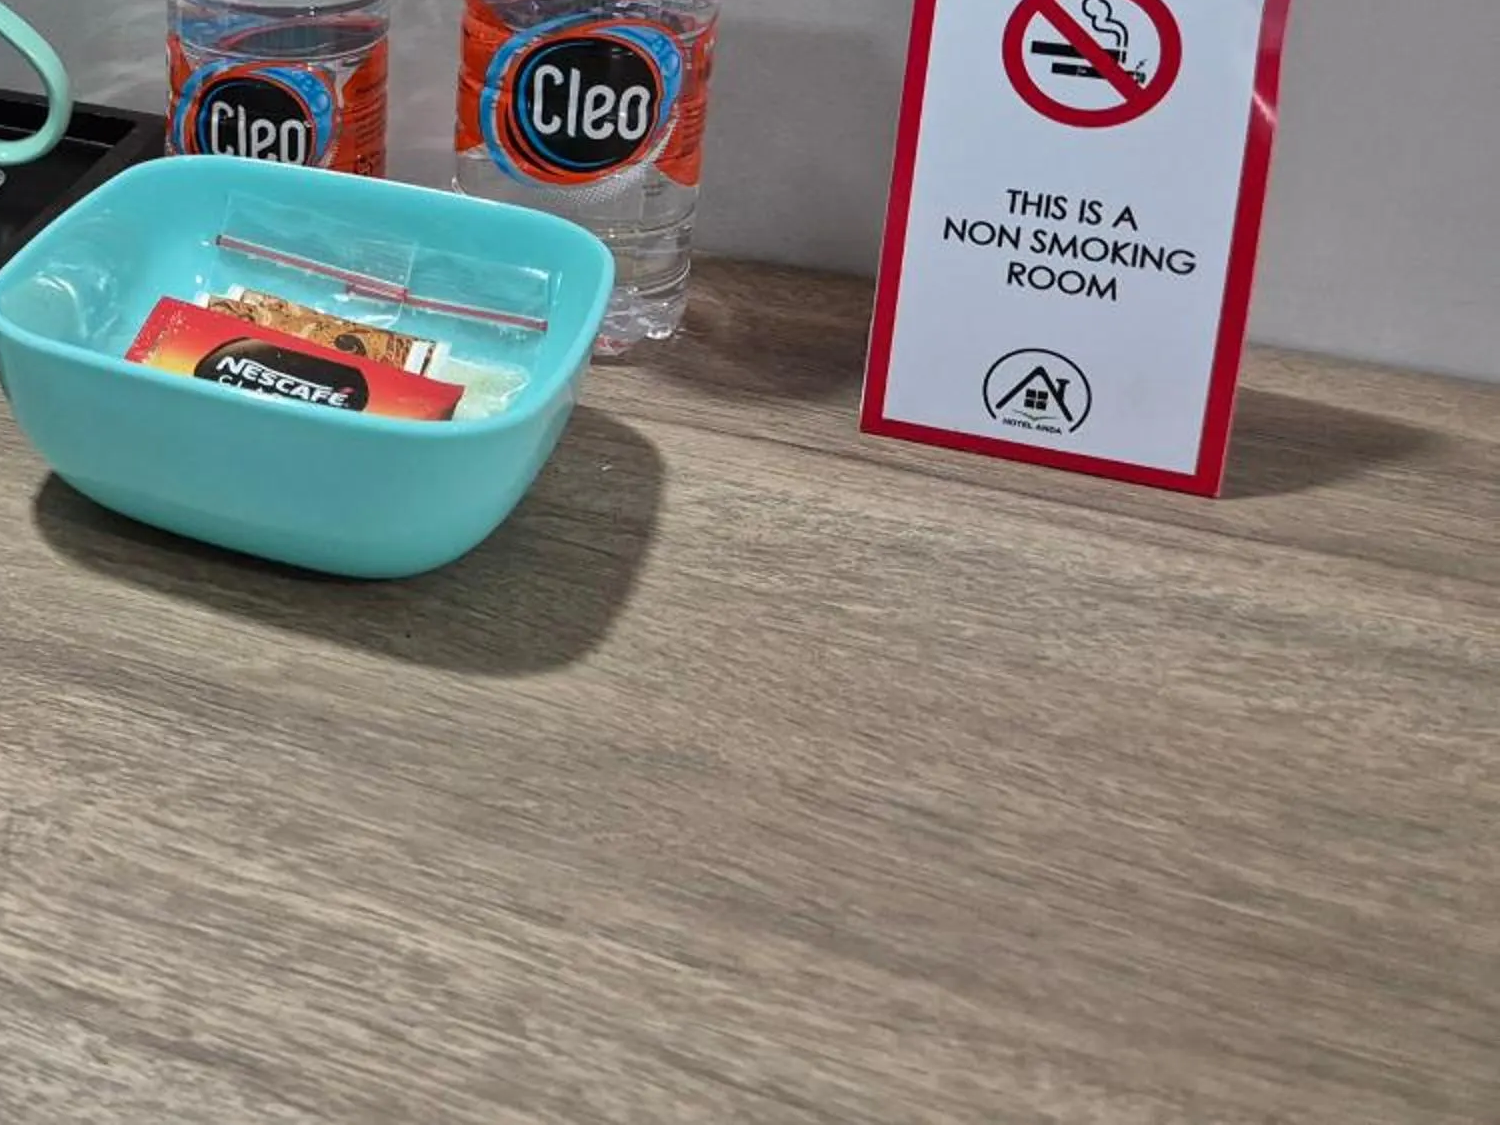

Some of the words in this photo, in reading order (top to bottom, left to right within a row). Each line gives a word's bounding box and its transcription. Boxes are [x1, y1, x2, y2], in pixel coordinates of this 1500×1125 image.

[533, 64, 651, 141] Cleo
[211, 100, 307, 165] Cleo
[1006, 189, 1068, 221] THIS
[1078, 198, 1103, 225] IS
[1112, 205, 1138, 231] A
[943, 216, 1021, 250] NON
[1029, 228, 1196, 276] SMOKING
[1006, 261, 1117, 301] ROOM
[216, 355, 355, 407] NESCAFÉ
[1003, 418, 1033, 430] HOTEL
[1036, 424, 1063, 435] ANDA
